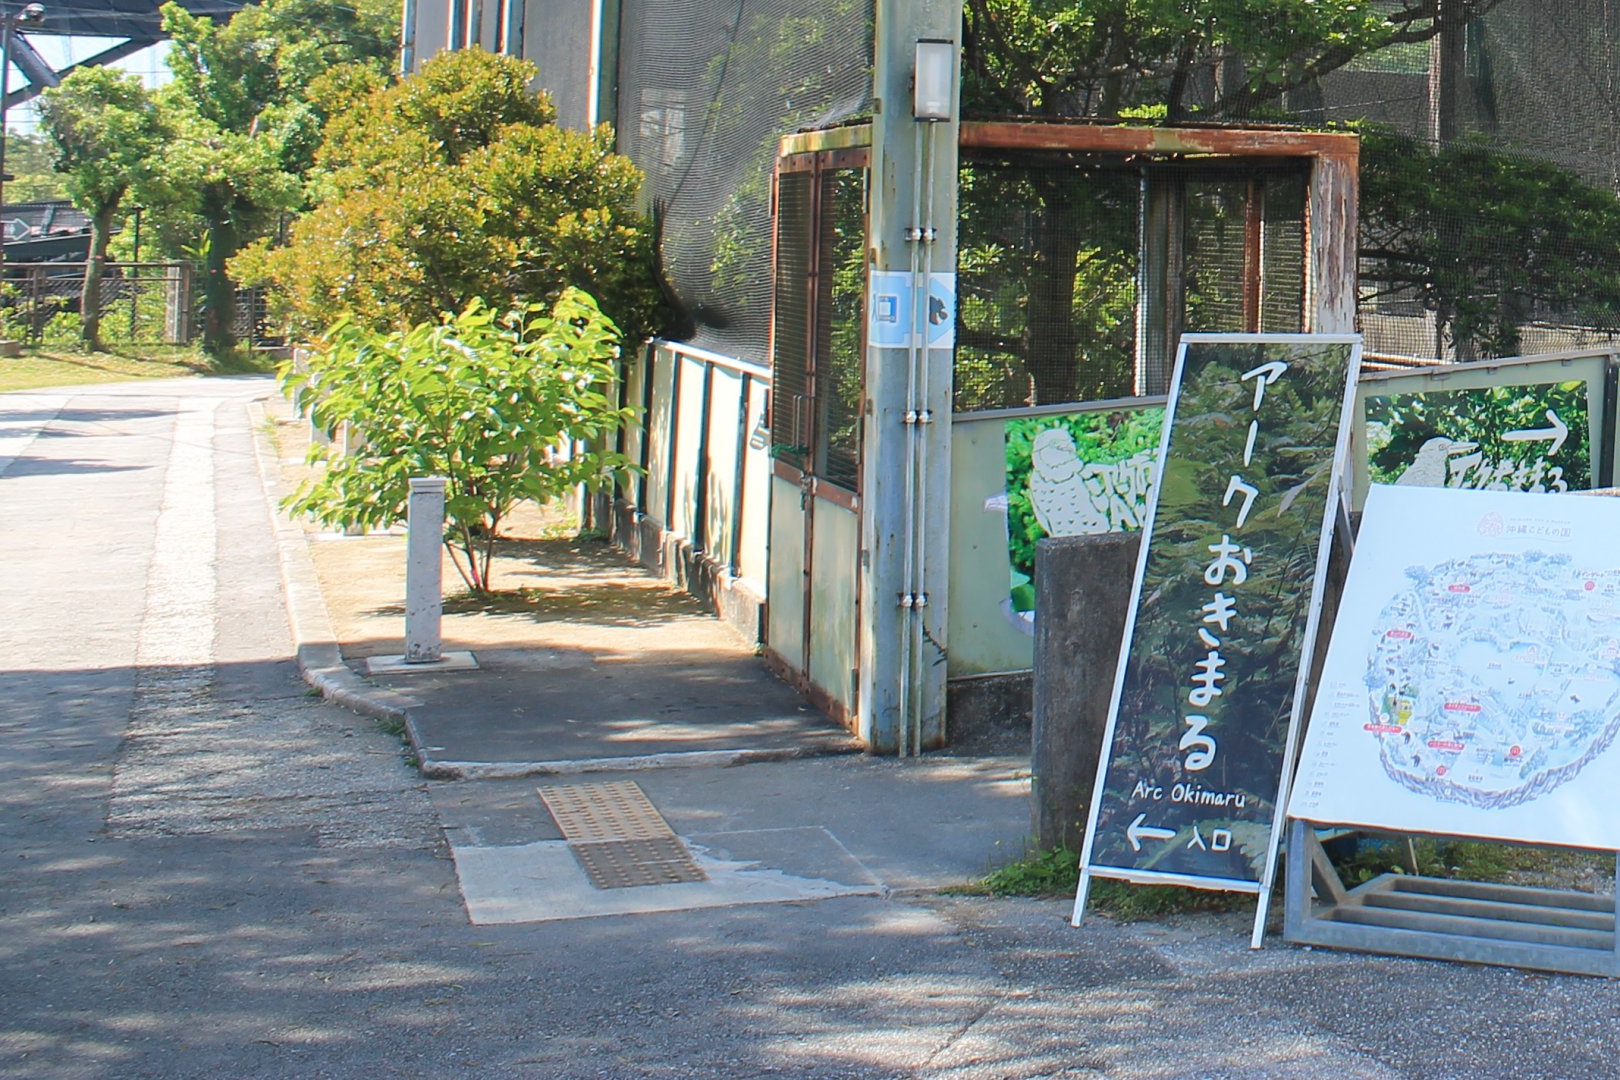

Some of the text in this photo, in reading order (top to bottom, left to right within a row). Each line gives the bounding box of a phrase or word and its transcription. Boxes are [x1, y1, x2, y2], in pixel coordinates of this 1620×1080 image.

[1180, 361, 1288, 772] アークおきまる
[1131, 780, 1246, 808] Arc Okimaru
[1186, 825, 1232, 851] 入口
